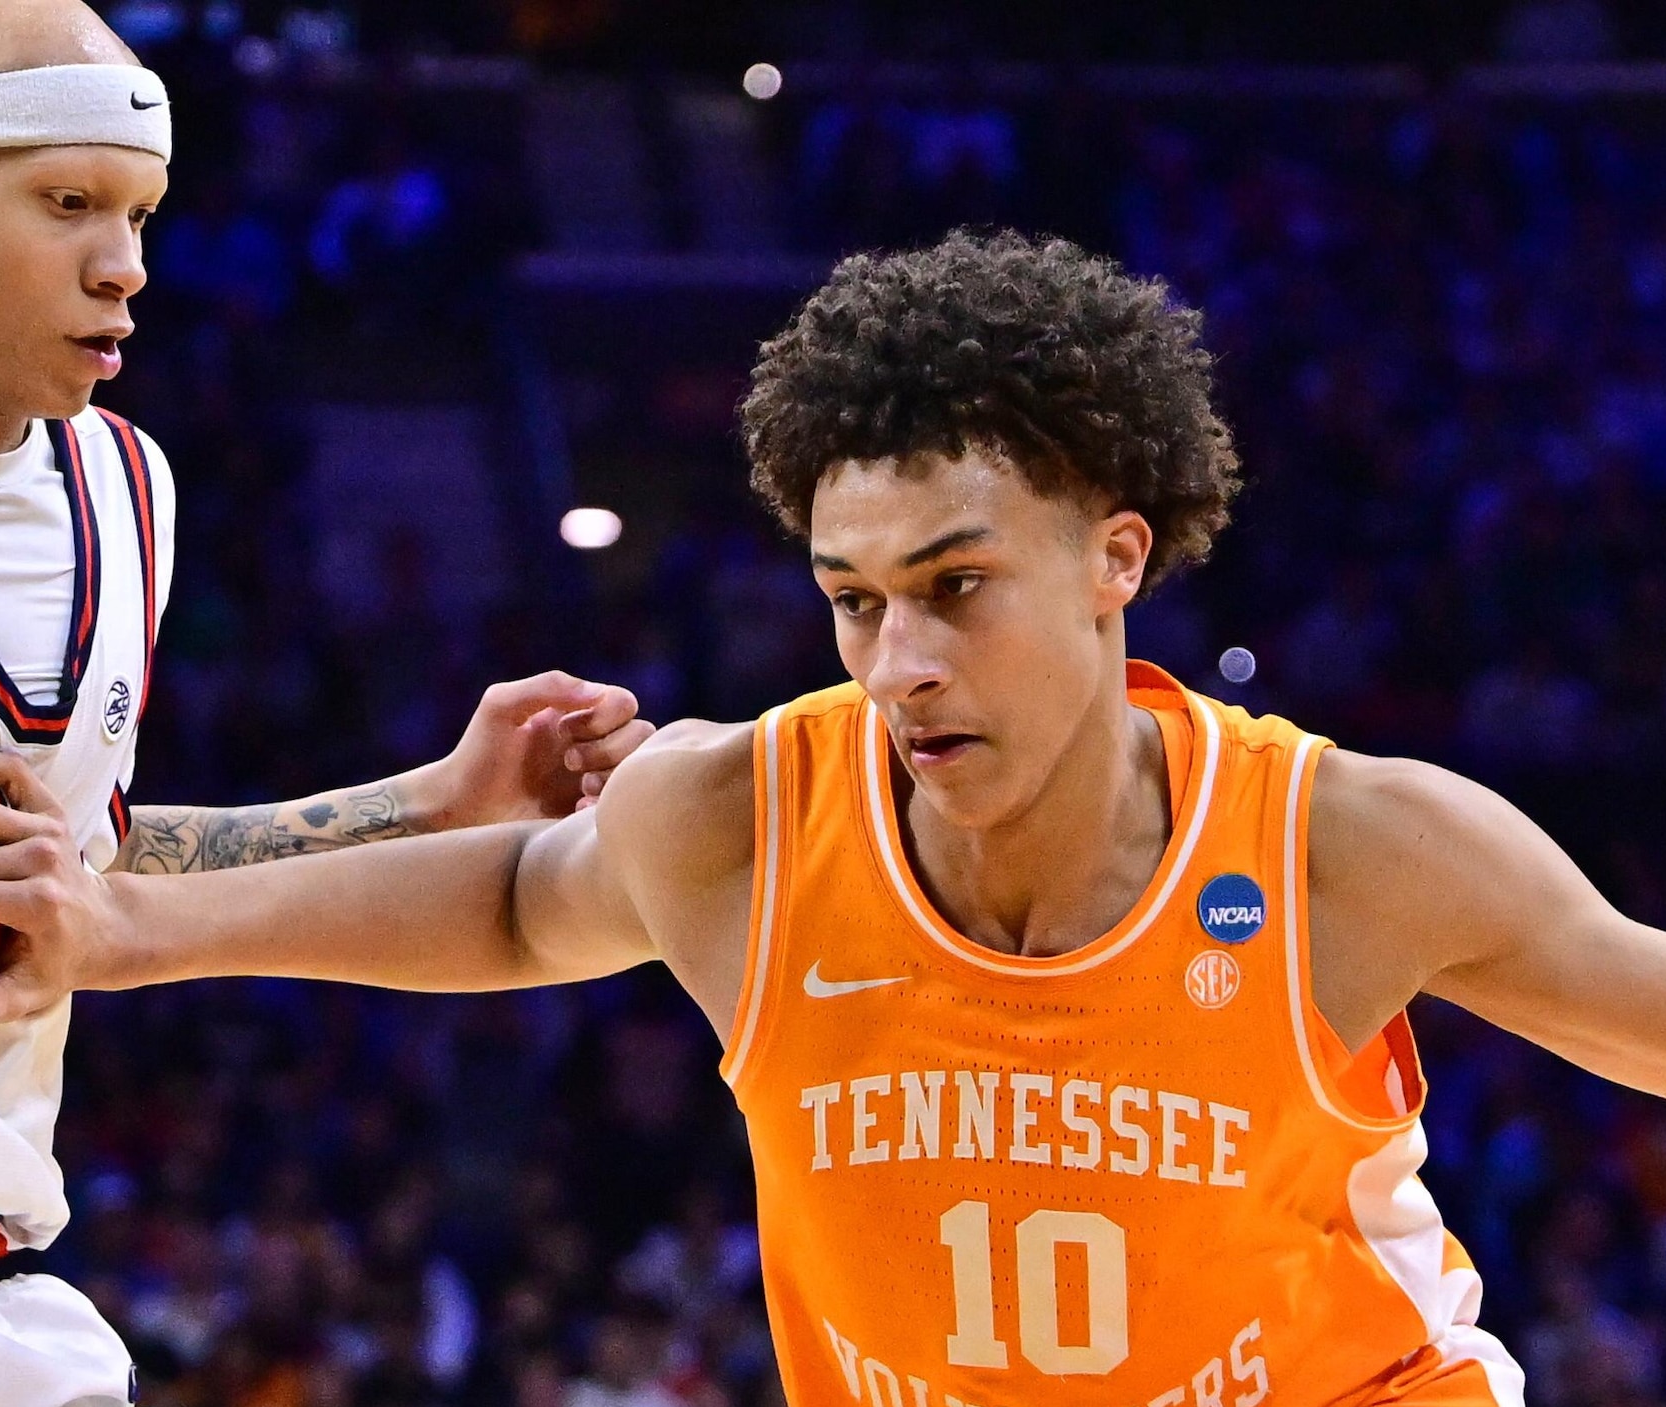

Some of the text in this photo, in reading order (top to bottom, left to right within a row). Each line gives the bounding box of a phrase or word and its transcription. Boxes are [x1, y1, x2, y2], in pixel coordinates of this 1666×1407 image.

[1207, 906, 1263, 926] NCAA
[1191, 955, 1235, 1004] SEC
[799, 1069, 1251, 1188] TENNESSEE
[939, 1200, 1130, 1376] 10
